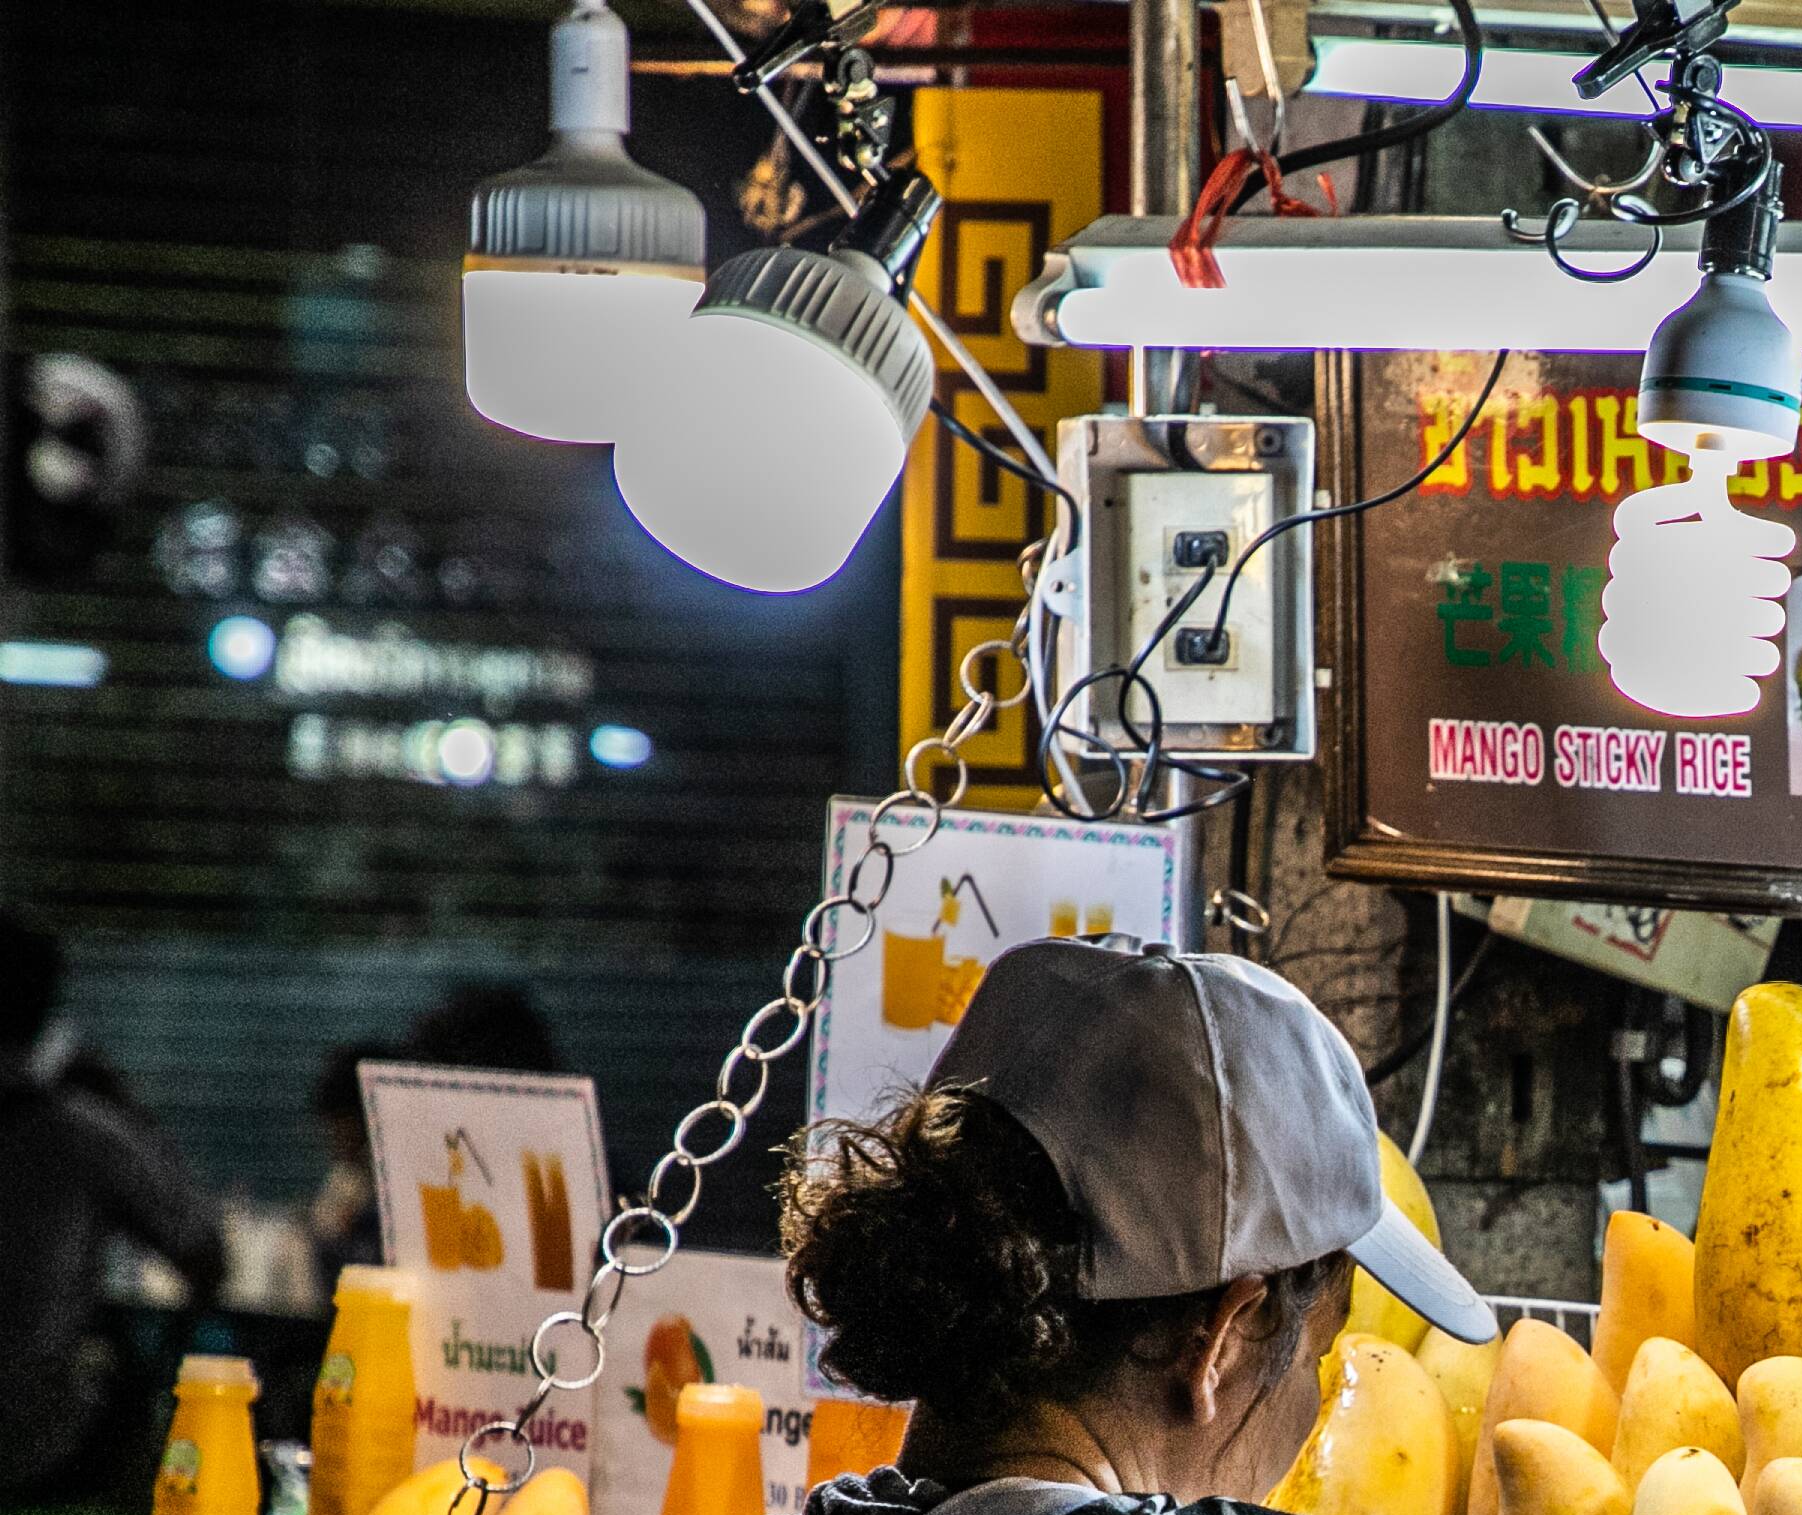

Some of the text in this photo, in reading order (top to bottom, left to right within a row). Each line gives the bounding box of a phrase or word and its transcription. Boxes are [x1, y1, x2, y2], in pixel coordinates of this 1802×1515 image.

[1429, 719, 1752, 797] MANGO STICKY RICE
